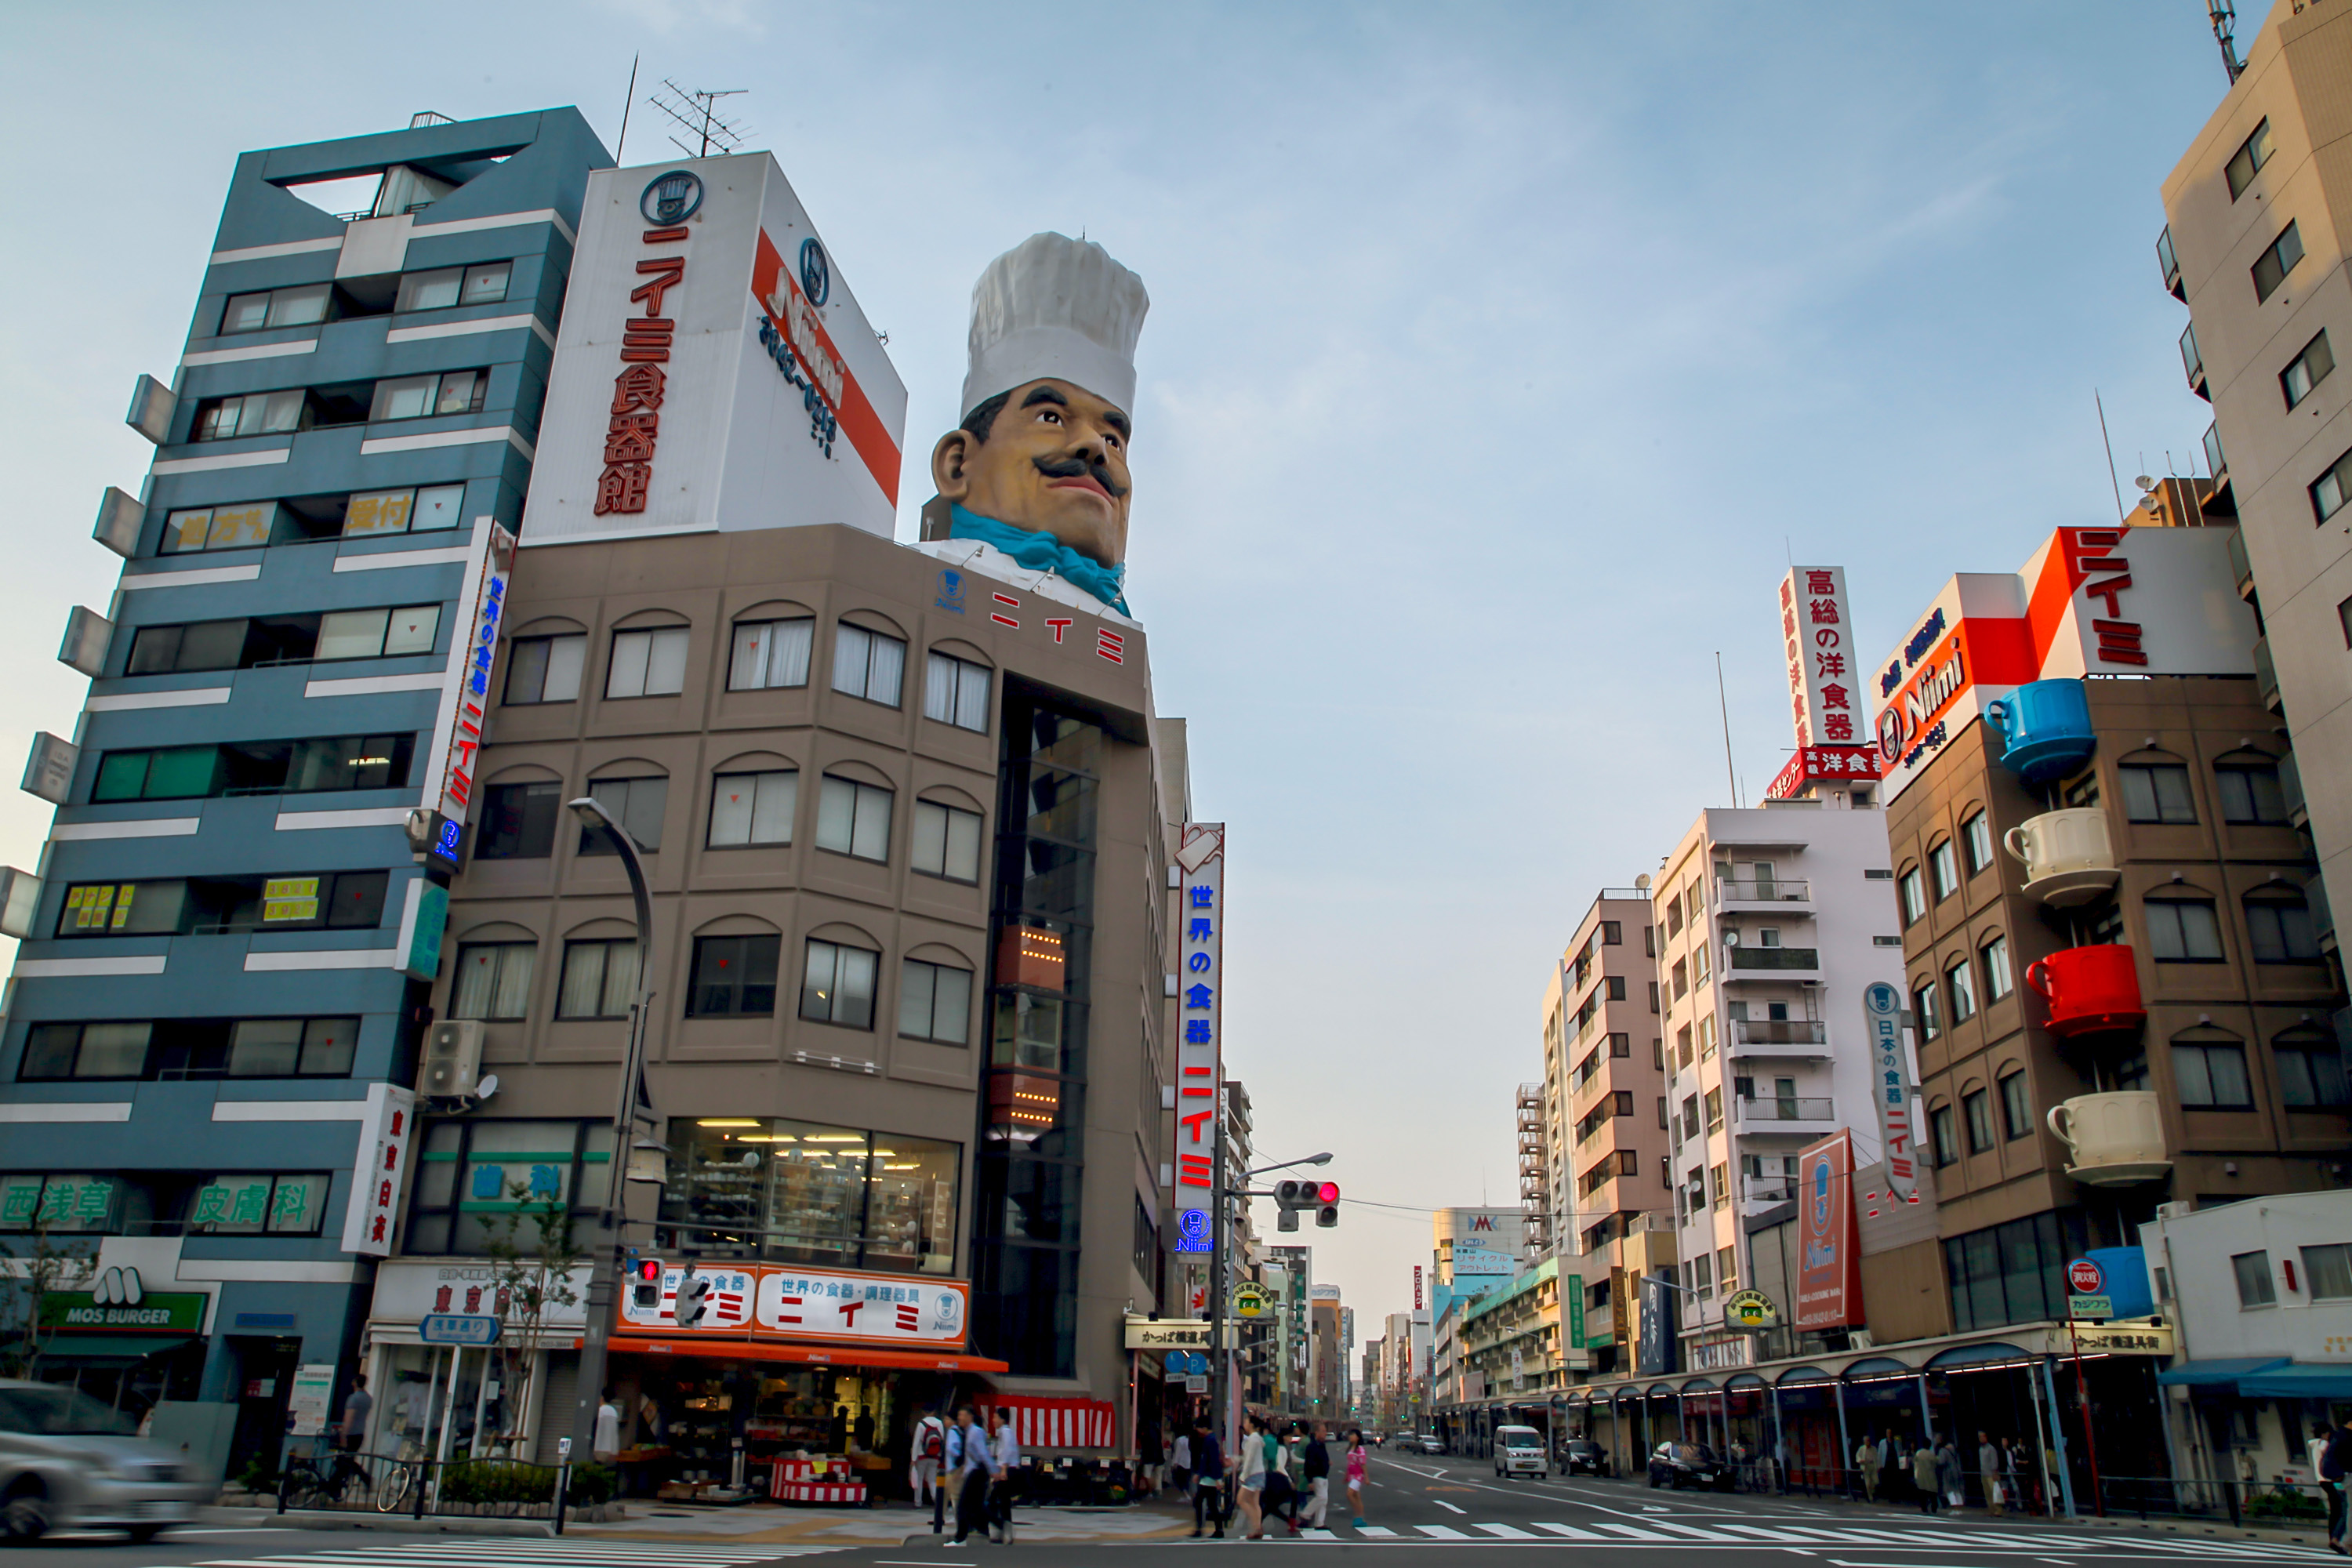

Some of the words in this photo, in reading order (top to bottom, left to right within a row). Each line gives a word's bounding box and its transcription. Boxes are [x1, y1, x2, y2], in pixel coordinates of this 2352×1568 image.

[766, 267, 844, 410] Niimi
[593, 226, 689, 516] ニイミ食器館
[177, 509, 268, 546] 処方せん
[346, 495, 410, 530] 受付
[2076, 531, 2148, 666] ニイミ
[472, 575, 504, 696] 世界の食器
[990, 592, 1124, 666] ニイミ
[1904, 637, 1965, 741] Niimi
[449, 702, 482, 806] ニイミ
[1768, 763, 1800, 798] 食器センター
[268, 883, 314, 895] 3821
[268, 904, 314, 916] 3927
[1185, 885, 1214, 1044] 世界の食器
[1878, 1020, 1902, 1104] 日本の食器
[1180, 1067, 1212, 1188] ニイミ
[1887, 1110, 1914, 1179] ニイミ
[472, 1164, 560, 1198] 歯科
[2, 1182, 113, 1224] 西浅草
[193, 1183, 307, 1225] 皮膚科
[1174, 1238, 1214, 1252] Niimi
[1804, 1234, 1836, 1272] Niimi
[781, 1279, 920, 1304] 世界の食器・調理器具
[2073, 1271, 2098, 1283] 消火栓
[66, 1308, 104, 1324] MOS
[107, 1308, 170, 1324] BURGER
[628, 1306, 655, 1316] Niimi
[778, 1296, 920, 1332] ニイミ
[2072, 1299, 2109, 1308] カジワラ
[932, 1321, 957, 1332] Niimi
[1142, 1330, 1212, 1344] かっぱ橋道具
[1191, 1359, 1199, 1373] P
